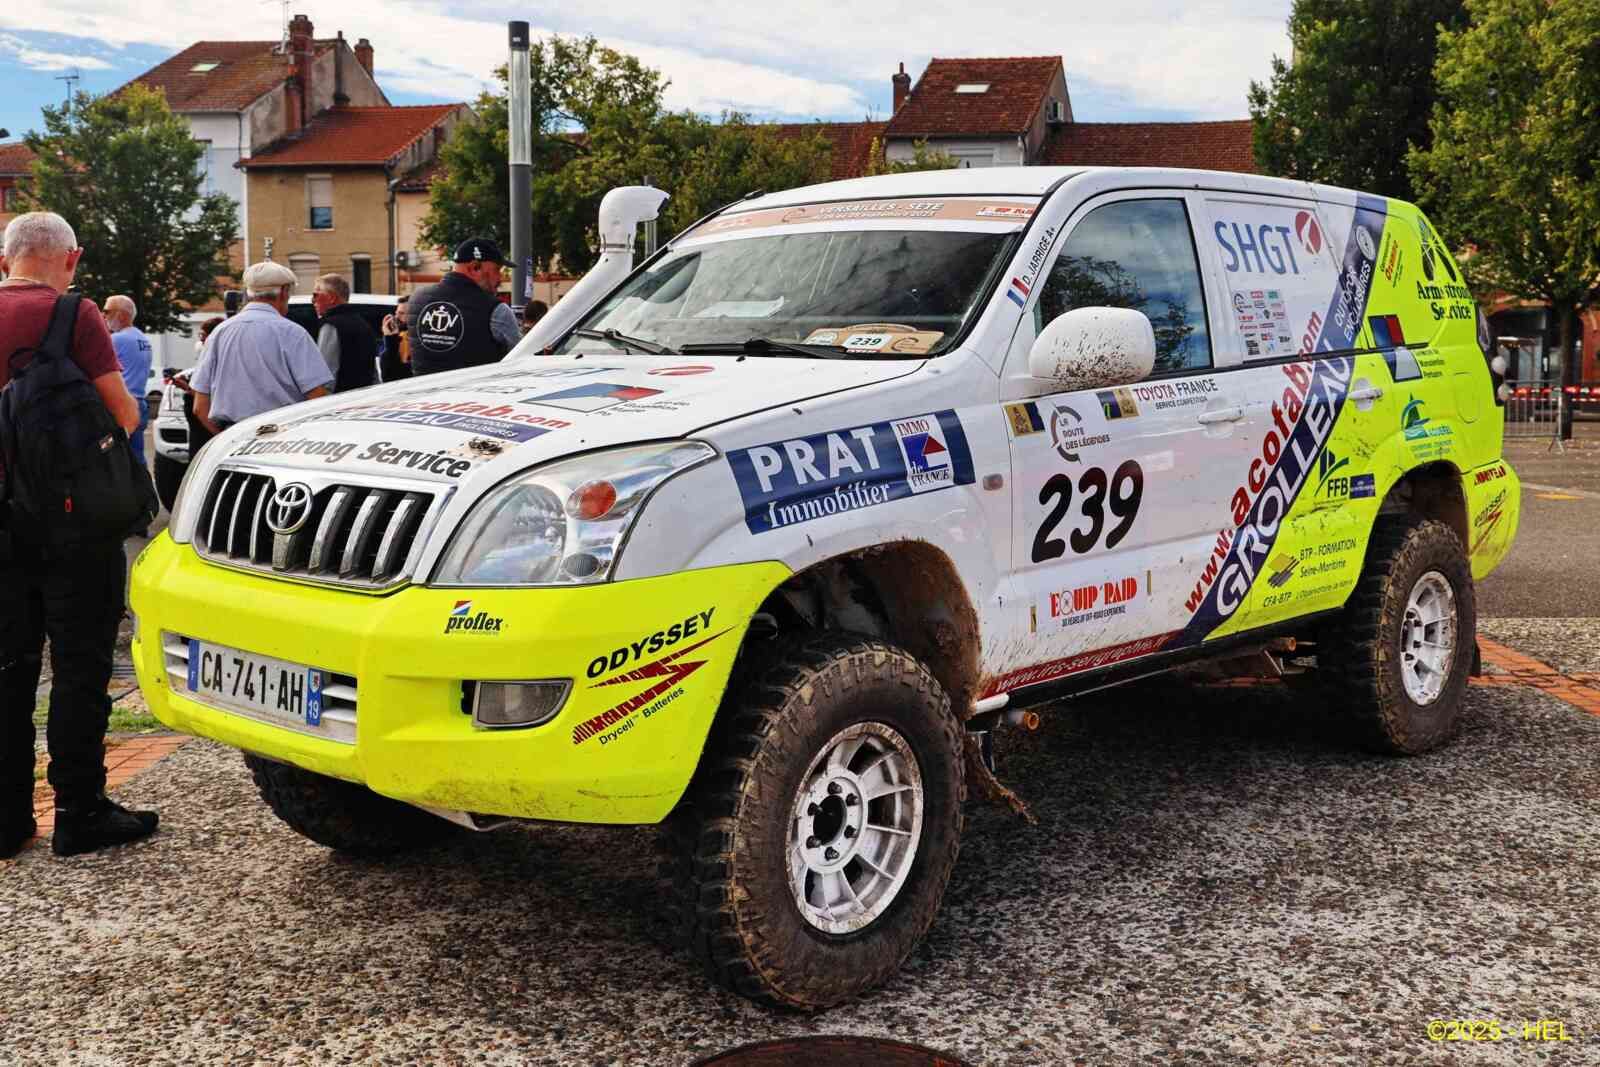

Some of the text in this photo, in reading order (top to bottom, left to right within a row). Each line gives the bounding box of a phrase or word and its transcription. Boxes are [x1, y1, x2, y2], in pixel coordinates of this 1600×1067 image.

[1028, 235, 1050, 275] JARRIGE
[1215, 220, 1299, 275] SHGT
[1343, 260, 1372, 342] ENCLOSURES
[851, 337, 883, 346] 239
[1133, 383, 1177, 402] TOYOTA
[1177, 378, 1218, 395] FRANCE
[1155, 400, 1177, 410] SERVICE
[896, 419, 930, 437] IMMO
[1063, 427, 1084, 438] ROUTE
[1065, 439, 1079, 450] DES
[230, 438, 471, 478] Armstrong Service
[747, 427, 881, 493] PRAT
[911, 468, 950, 487] FRANCE
[1217, 337, 1350, 616] GROLLEAU
[1327, 477, 1348, 497] FFB
[767, 480, 890, 528] Immobilier
[1031, 459, 1144, 564] 239
[1300, 547, 1313, 561] BTP
[1318, 537, 1357, 557] FORMATION
[1300, 558, 1347, 578] Seine-Maritime
[444, 611, 504, 634] proflex
[587, 606, 716, 679] ODYSSEY
[308, 701, 320, 719] 19
[642, 687, 685, 718] Batteries
